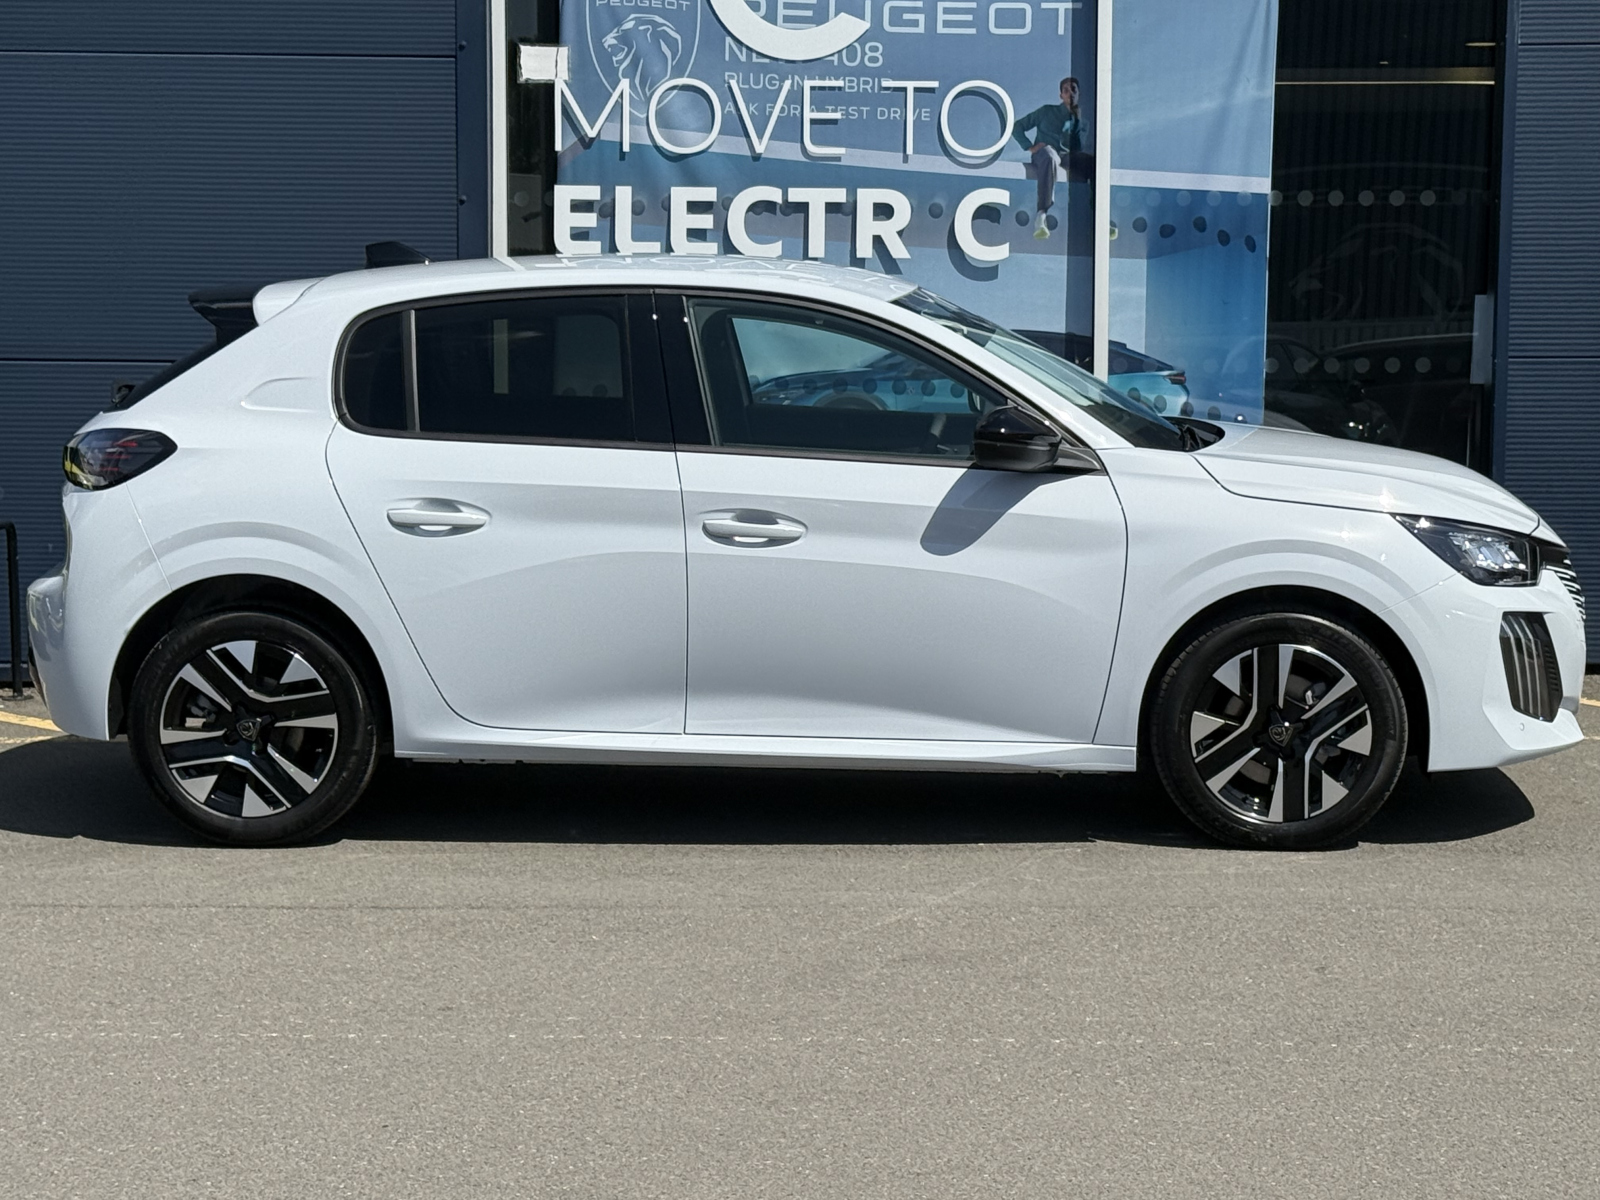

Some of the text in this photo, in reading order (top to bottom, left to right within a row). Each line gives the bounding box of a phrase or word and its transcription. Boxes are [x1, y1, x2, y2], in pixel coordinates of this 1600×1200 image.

[554, 78, 1015, 157] MOVE TO
[724, 101, 759, 116] AK
